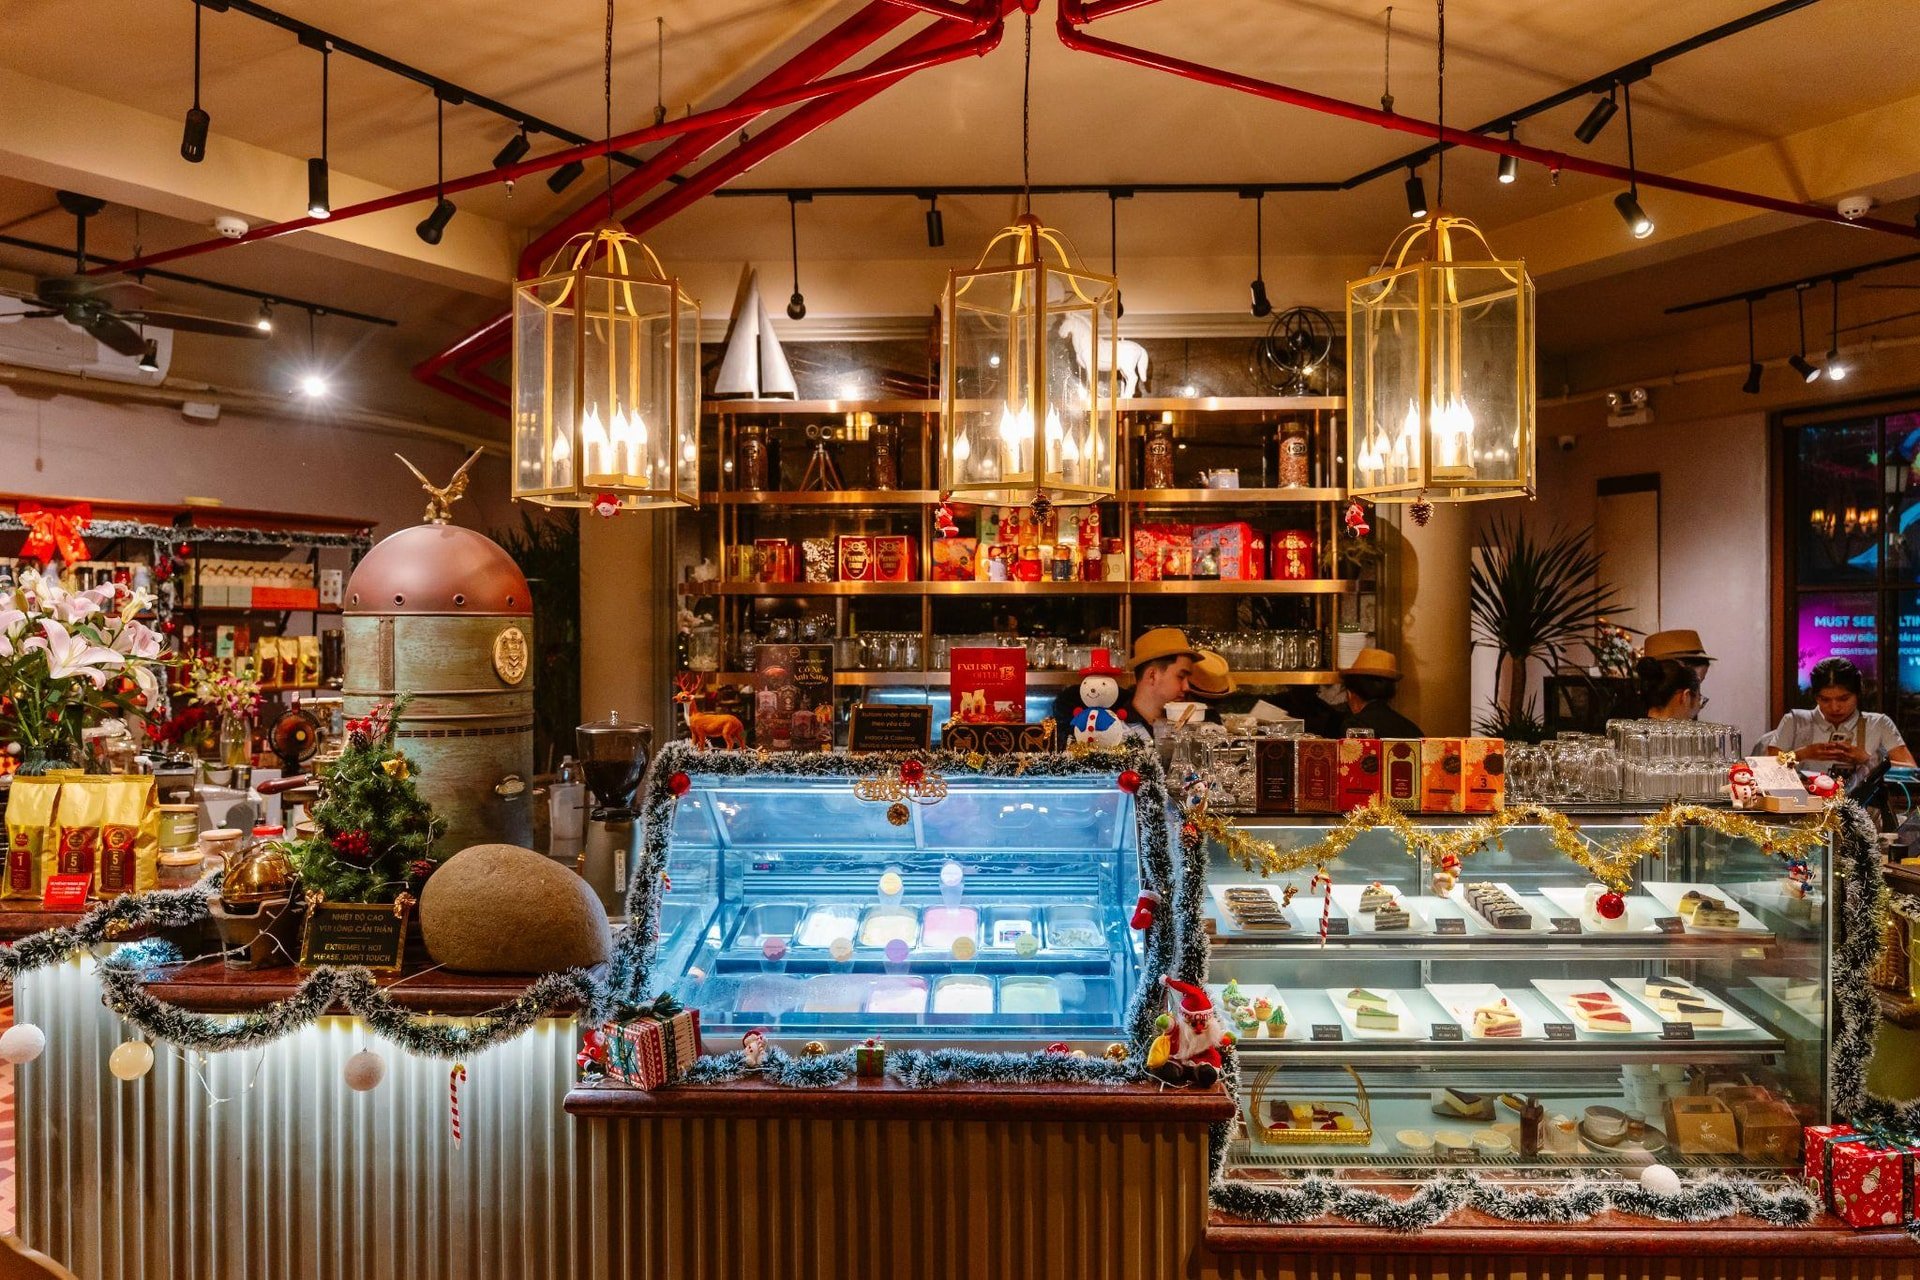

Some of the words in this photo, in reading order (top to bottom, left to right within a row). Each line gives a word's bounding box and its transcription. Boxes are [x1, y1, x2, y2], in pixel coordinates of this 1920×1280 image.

[1814, 616, 1850, 627] MUST
[1852, 616, 1875, 627] SEE
[1830, 633, 1857, 643] SHOW
[957, 663, 999, 671] EXCLUSIVE
[1480, 777, 1487, 788] 3
[17, 855, 23, 866] 1
[70, 855, 78, 867] 5
[111, 853, 119, 865] 5
[324, 943, 366, 951] EXTREMELY
[367, 944, 382, 952] HOT
[365, 954, 391, 962] TOUCH
